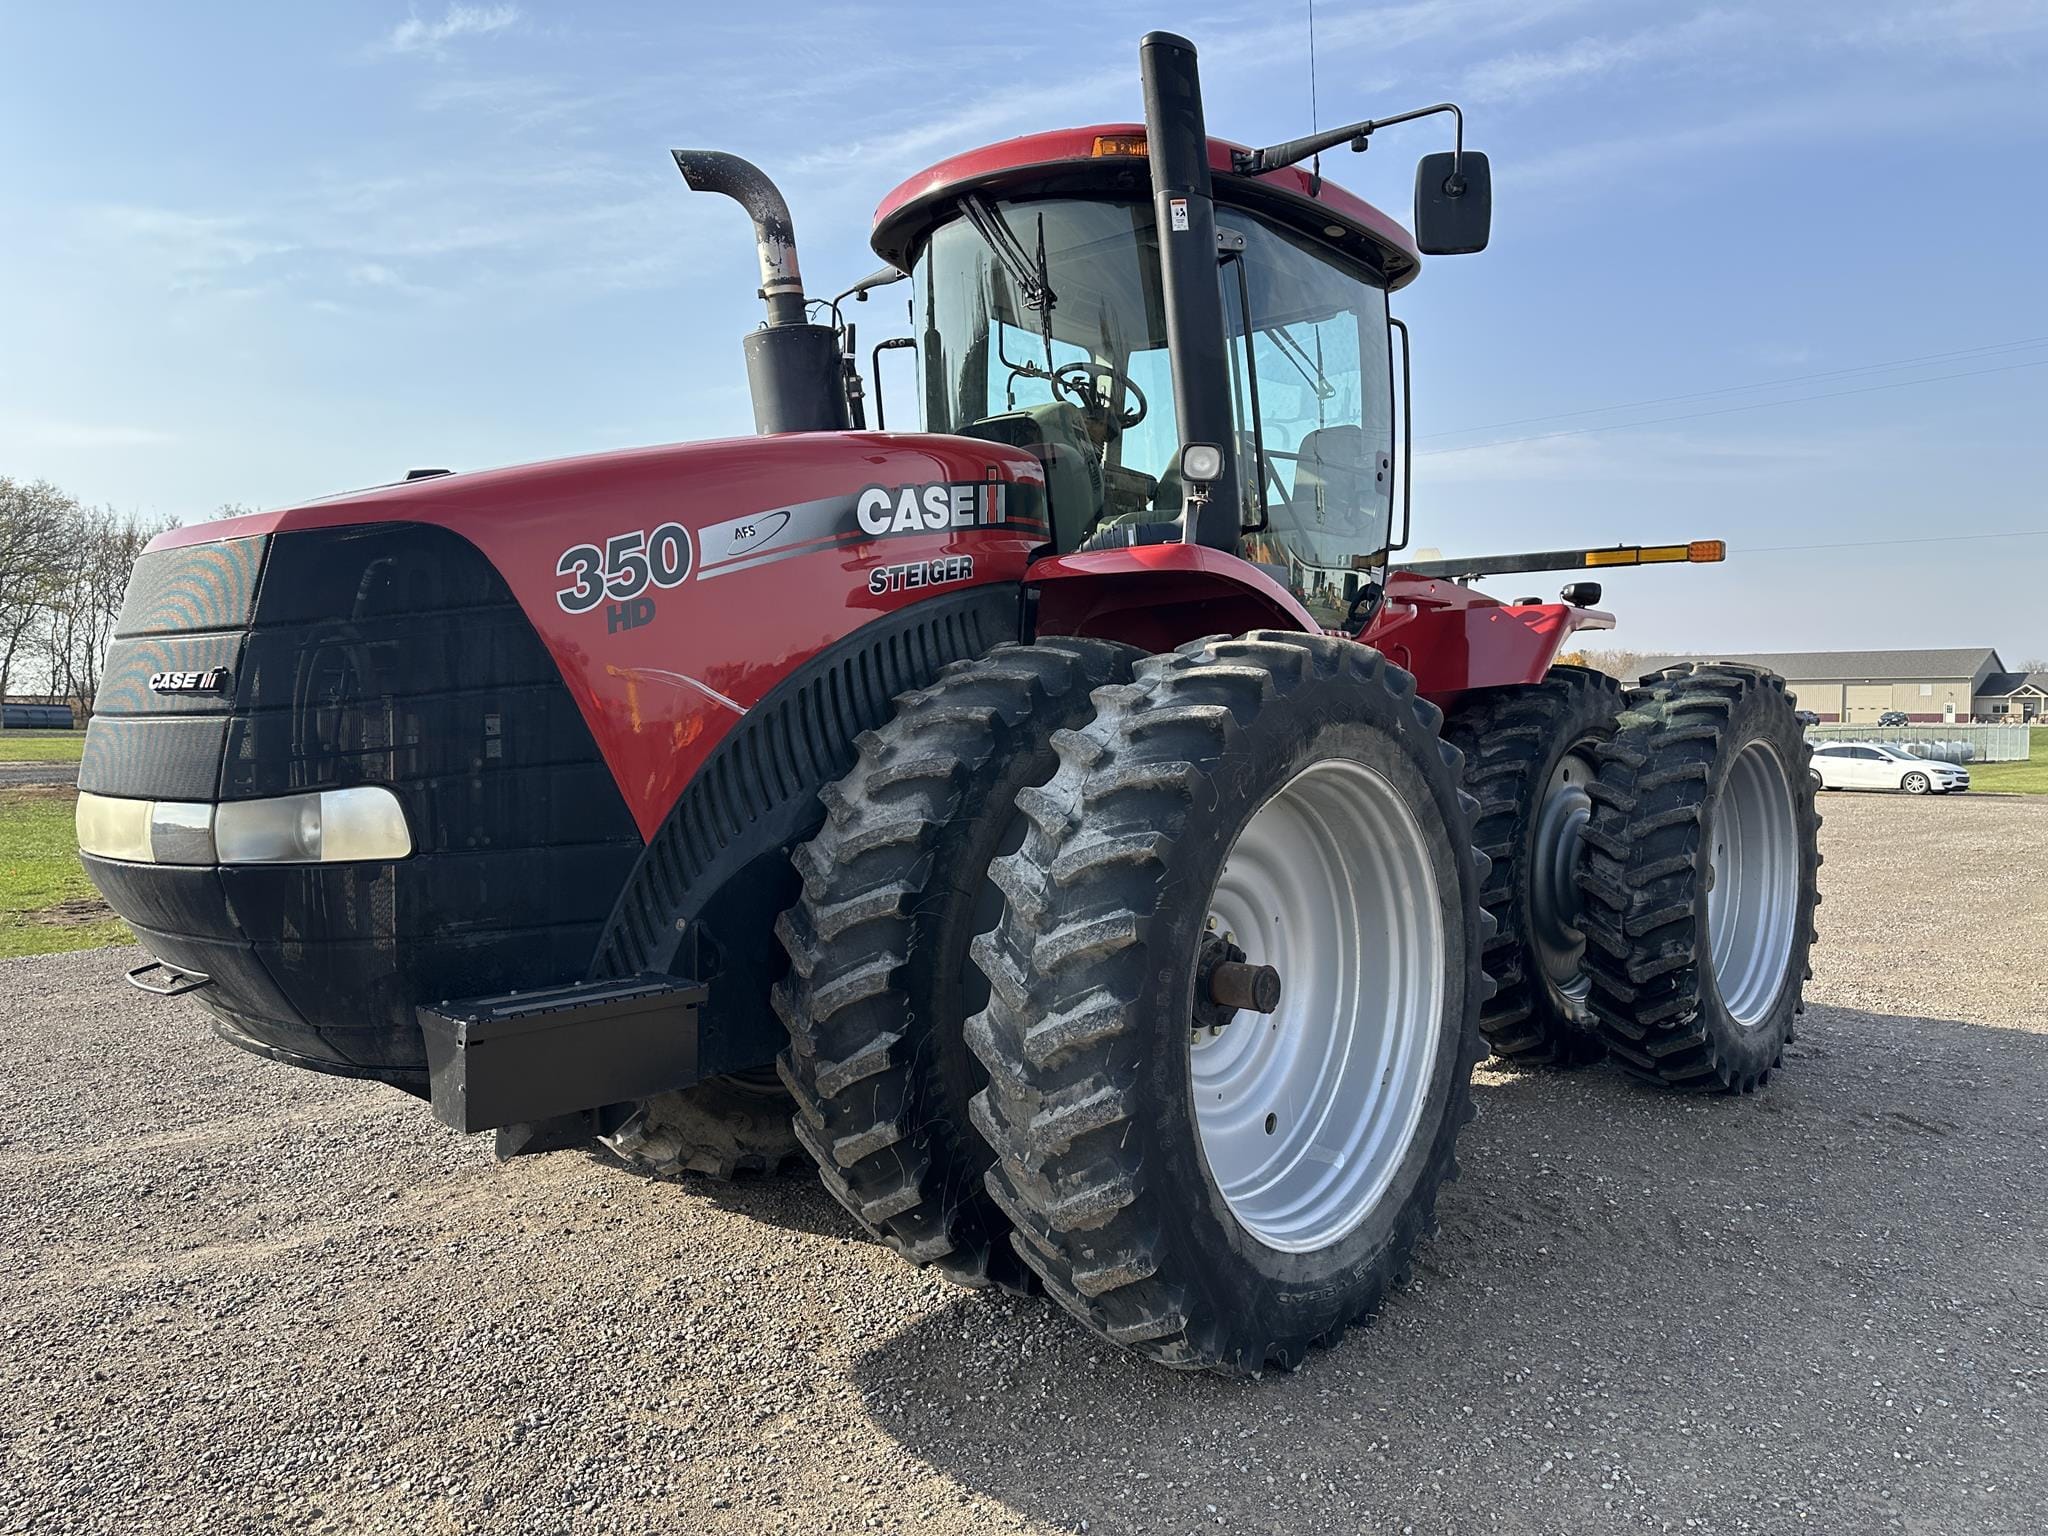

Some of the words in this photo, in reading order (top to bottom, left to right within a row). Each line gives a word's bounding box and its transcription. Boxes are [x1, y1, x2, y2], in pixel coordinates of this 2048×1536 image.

[857, 486, 974, 535] CASE
[735, 525, 756, 540] AFS
[556, 521, 693, 614] 350
[868, 554, 974, 595] STEIGER
[606, 597, 657, 635] HD
[148, 670, 198, 690] CASE
